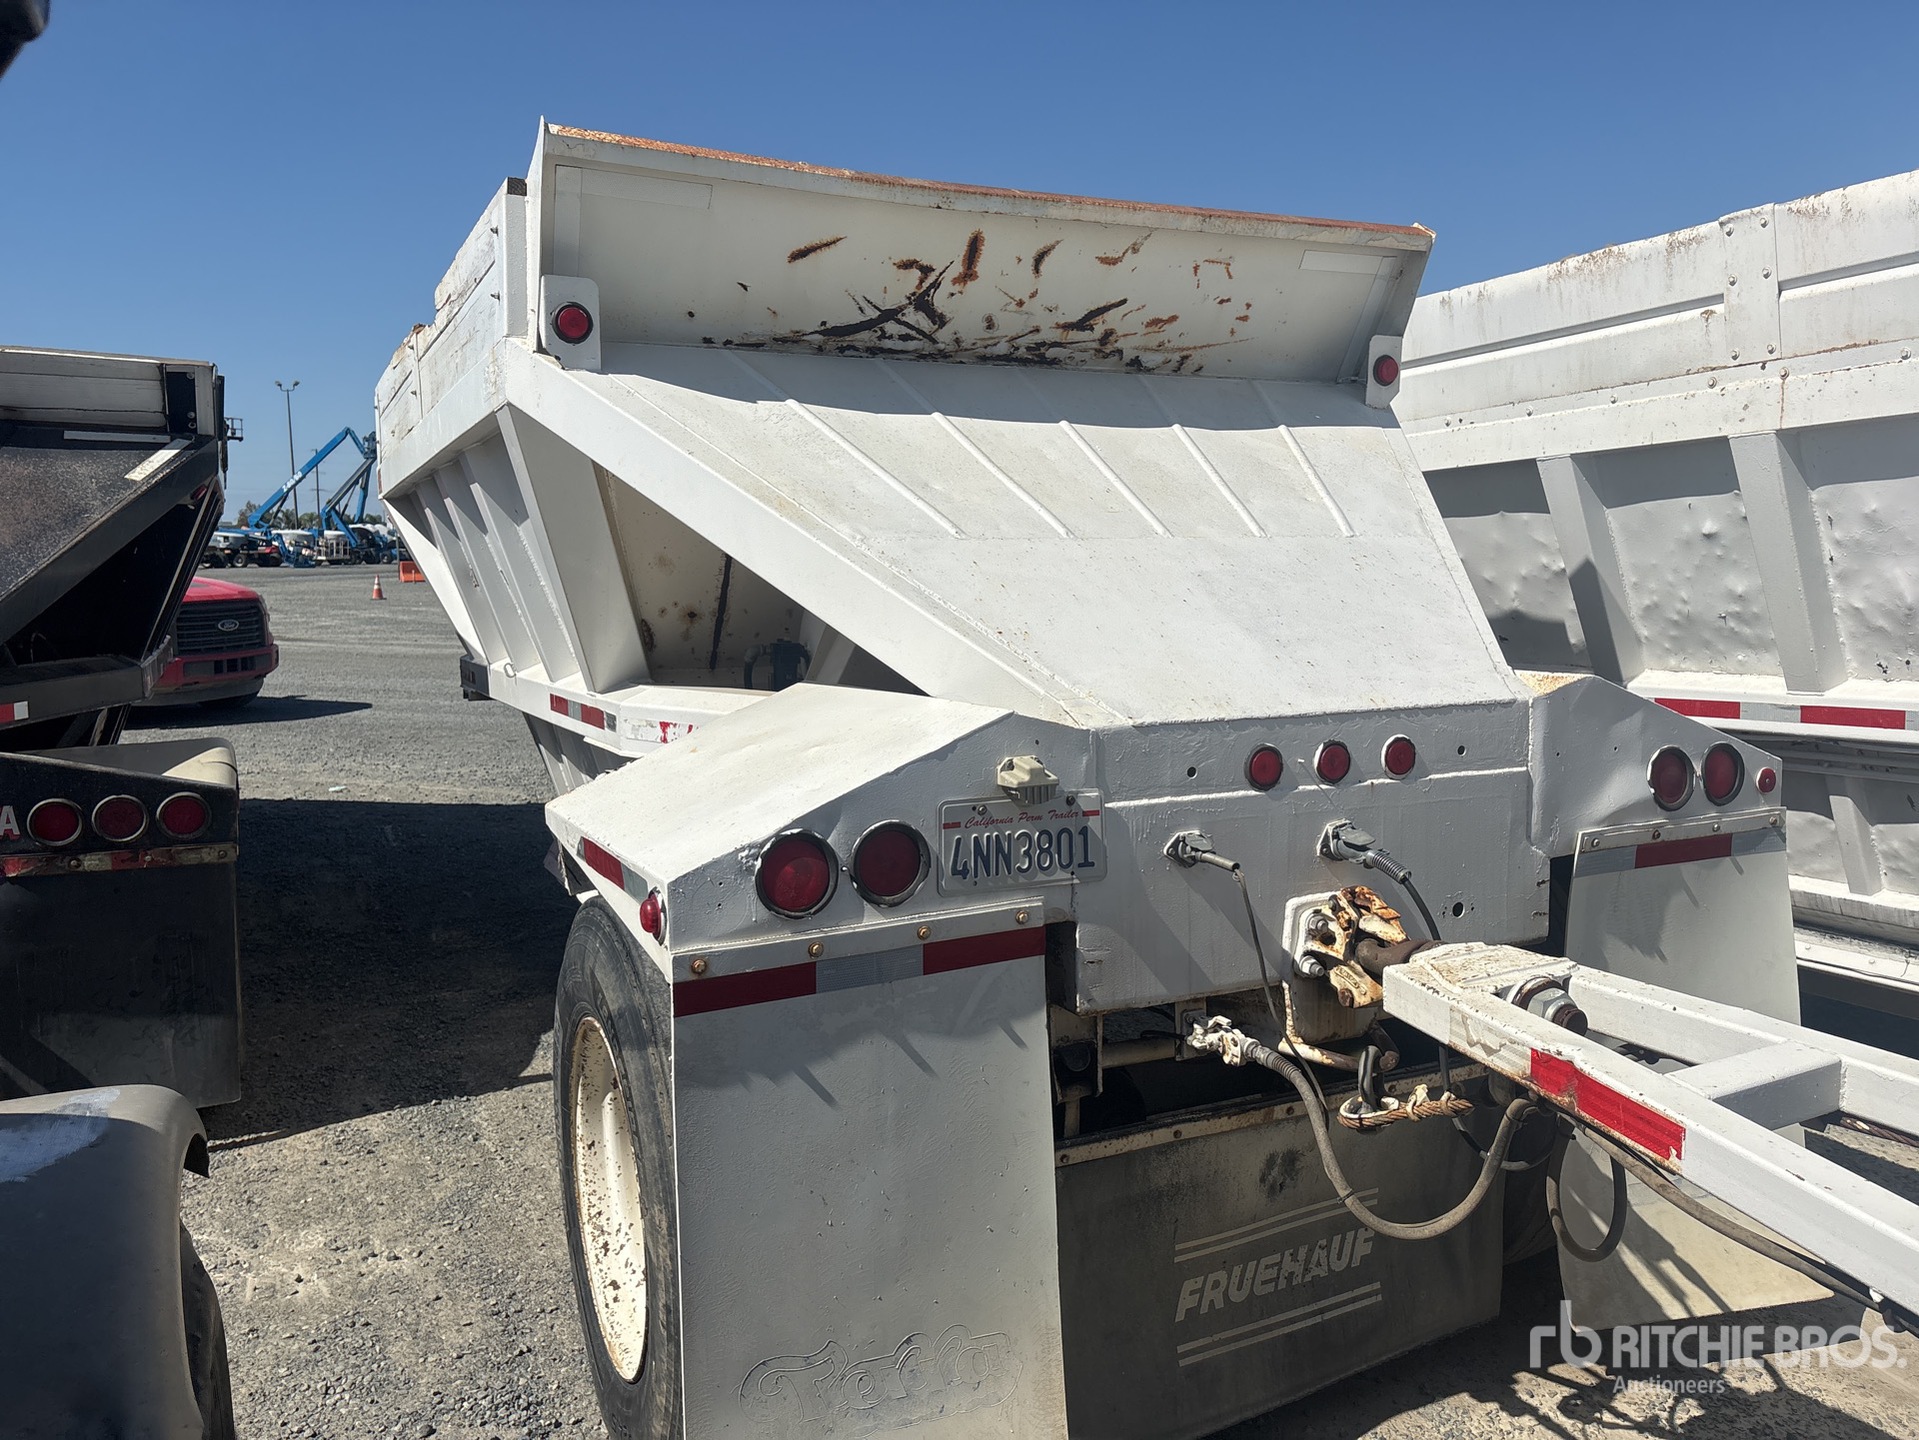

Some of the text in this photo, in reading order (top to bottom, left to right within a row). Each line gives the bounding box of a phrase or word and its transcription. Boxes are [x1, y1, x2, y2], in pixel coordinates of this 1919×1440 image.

[964, 809, 1080, 829] California Perm Trailer
[950, 825, 1095, 880] 4NN3801
[1175, 1228, 1376, 1323] FRUEHAUF
